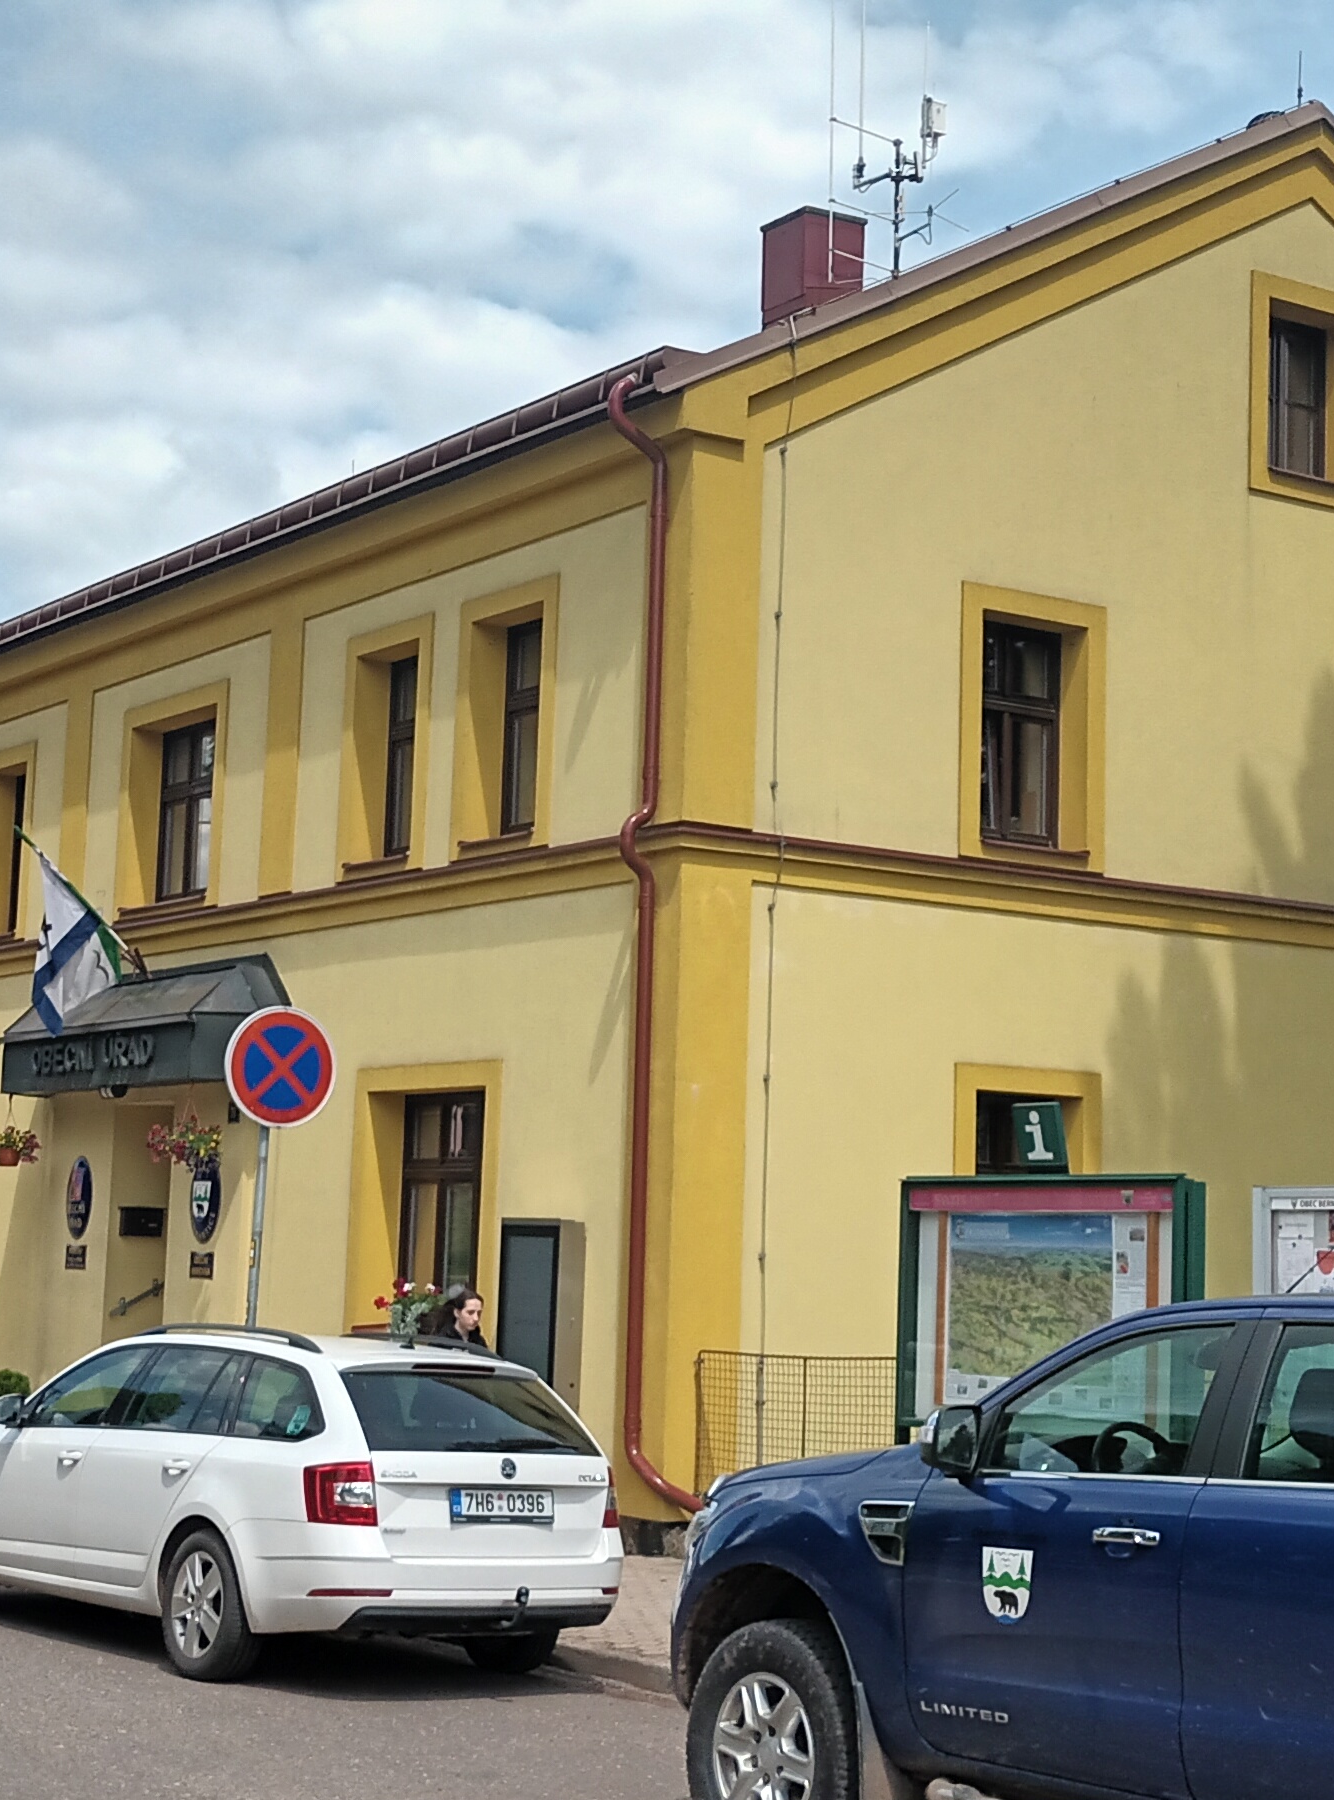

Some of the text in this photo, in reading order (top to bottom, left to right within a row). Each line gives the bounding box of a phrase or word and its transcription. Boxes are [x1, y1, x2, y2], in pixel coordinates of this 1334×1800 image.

[1025, 1110, 1054, 1160] i
[465, 1492, 545, 1514] 7H6 0396
[920, 1700, 1009, 1723] LIMITED
